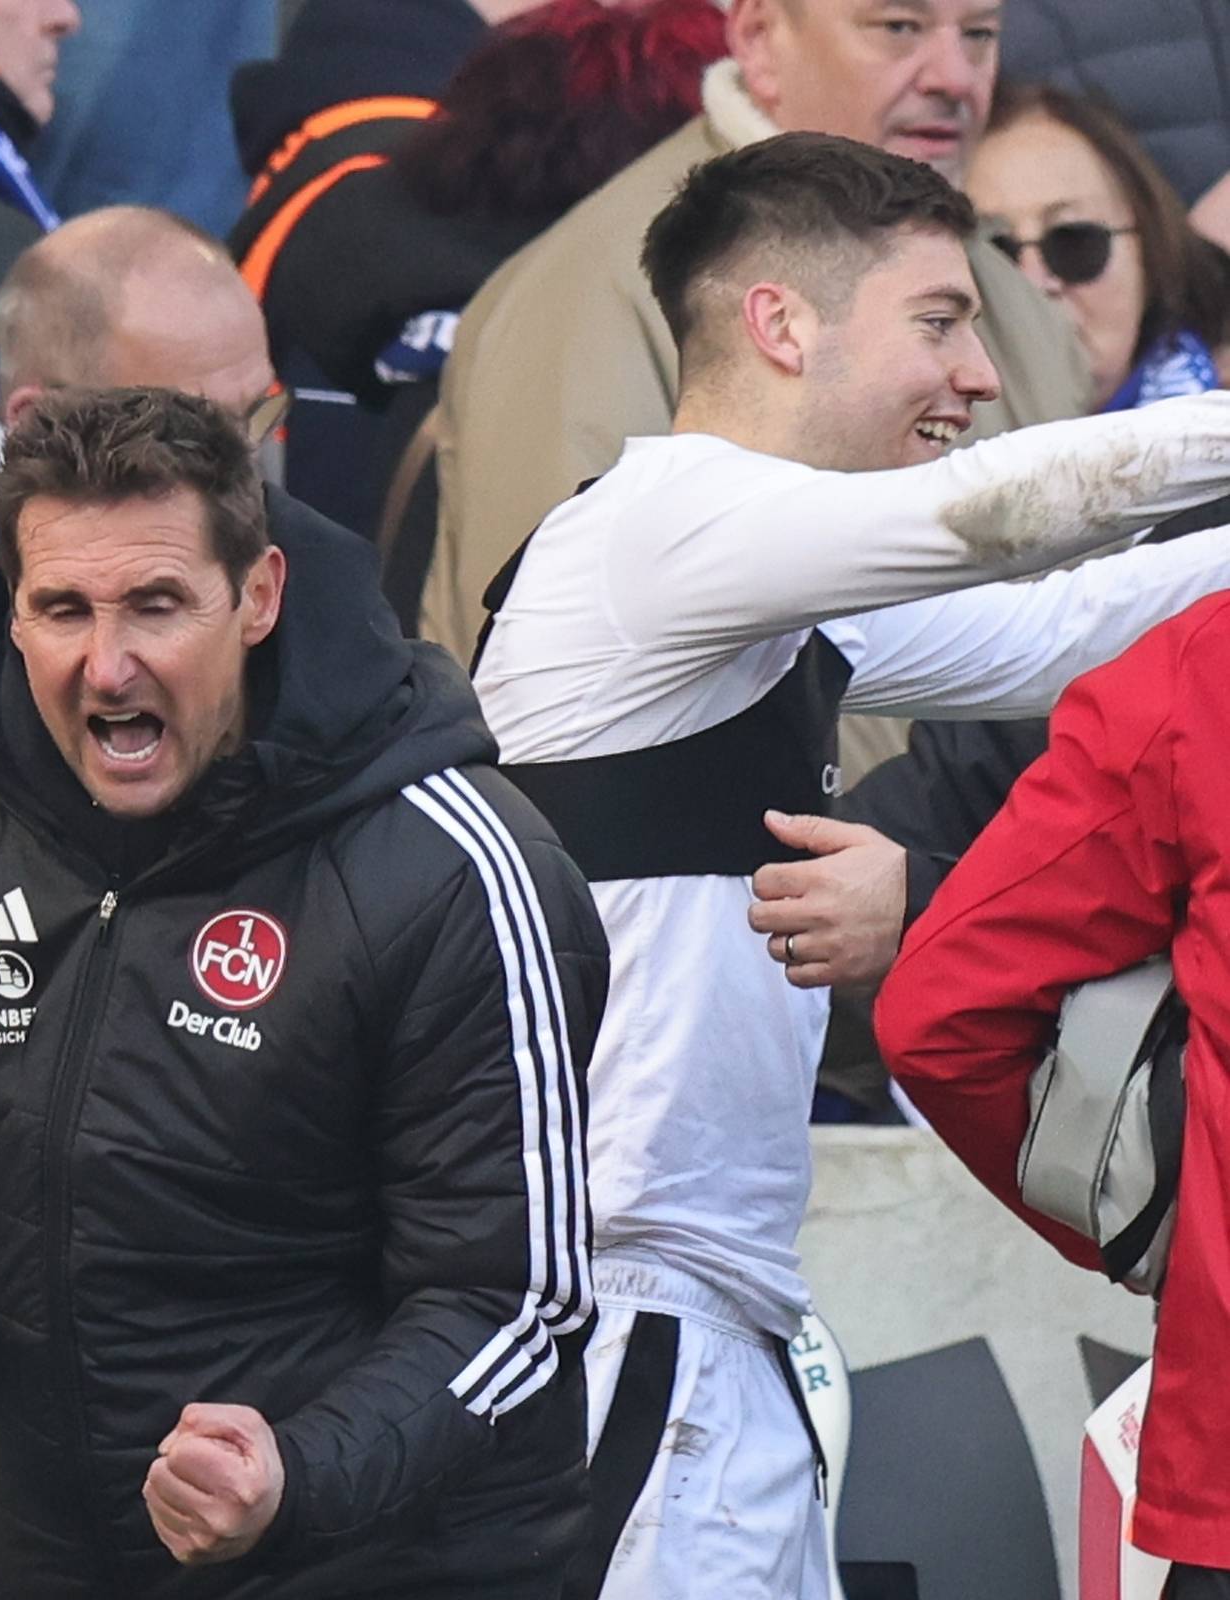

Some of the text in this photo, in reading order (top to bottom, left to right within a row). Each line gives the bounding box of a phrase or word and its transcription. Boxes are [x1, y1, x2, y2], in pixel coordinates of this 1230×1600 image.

[200, 940, 275, 990] FCN
[167, 1000, 261, 1051] Der Club
